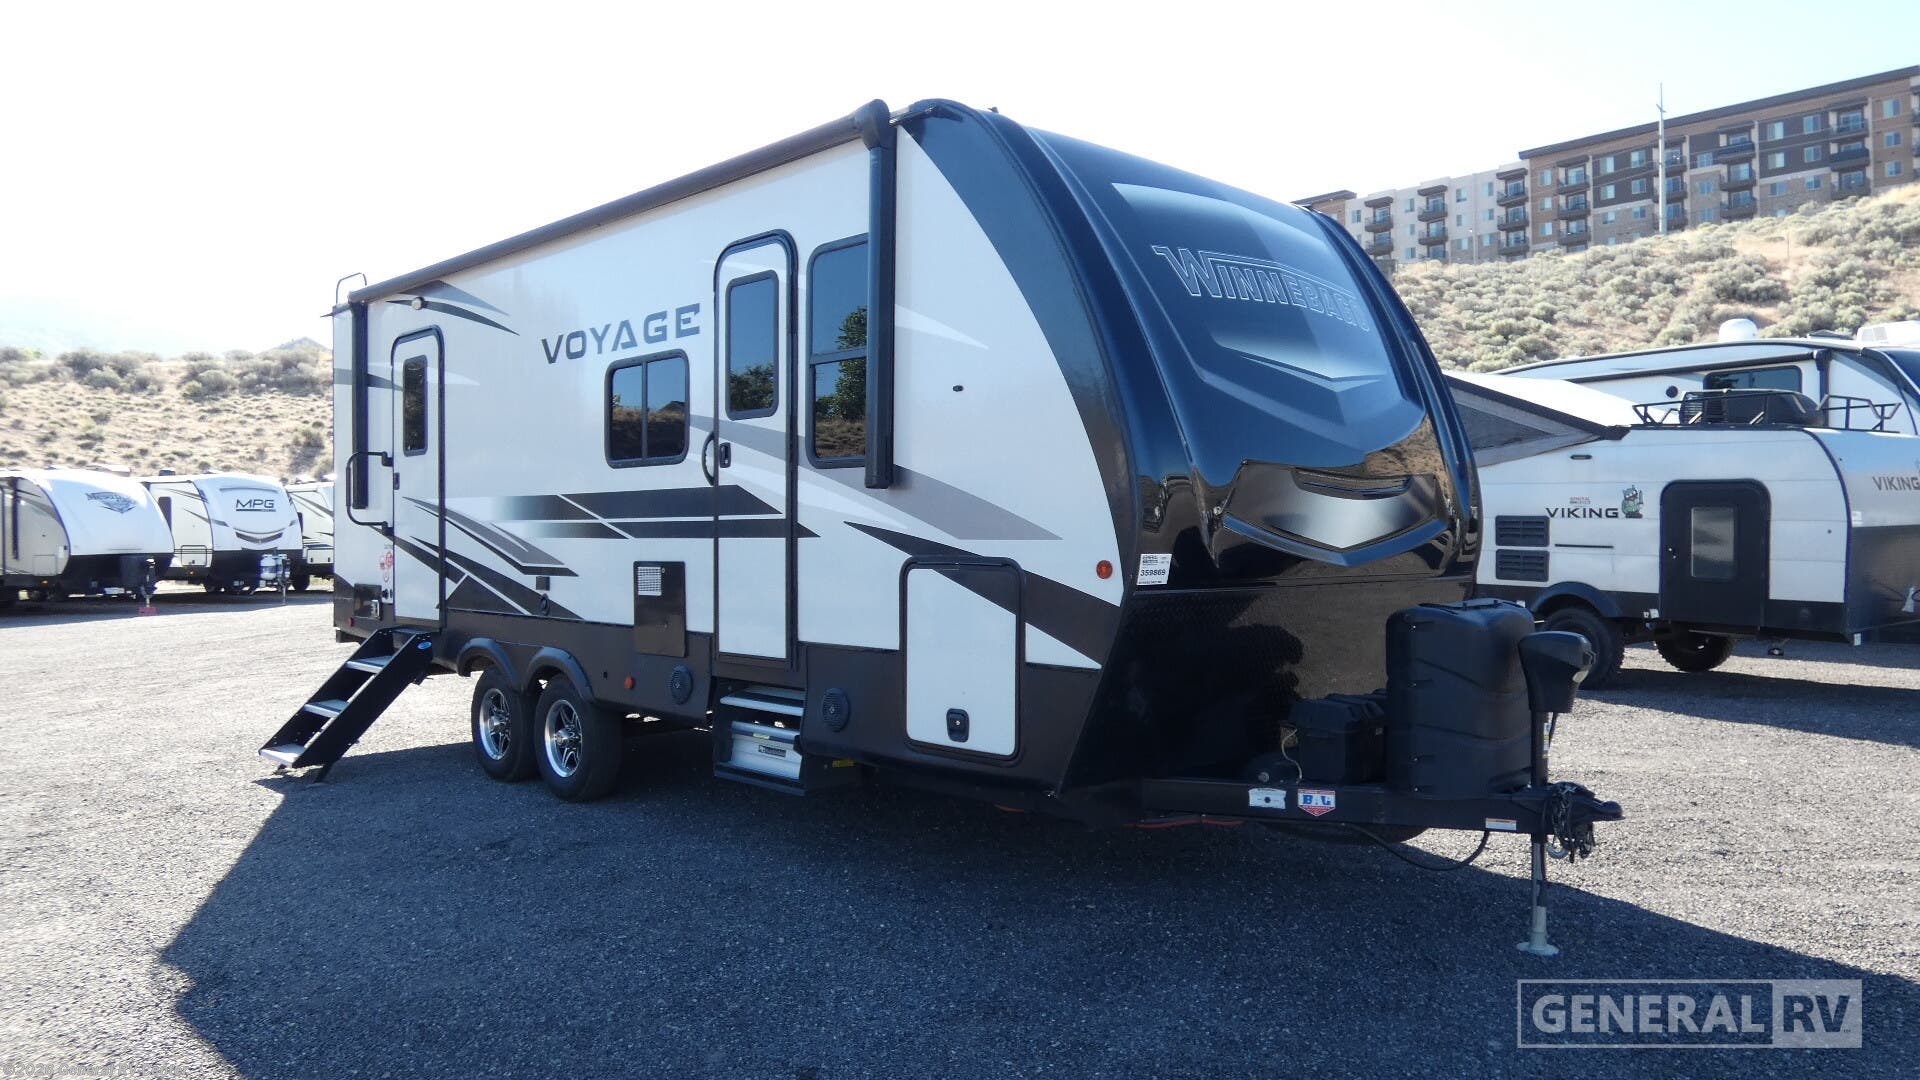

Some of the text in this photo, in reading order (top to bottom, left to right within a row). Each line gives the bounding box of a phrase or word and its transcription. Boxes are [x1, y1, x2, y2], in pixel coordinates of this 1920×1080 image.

[541, 303, 700, 364] VOYAGE
[1873, 476, 1920, 491] VIKING
[236, 499, 274, 508] MPG
[1545, 507, 1619, 518] VIKING
